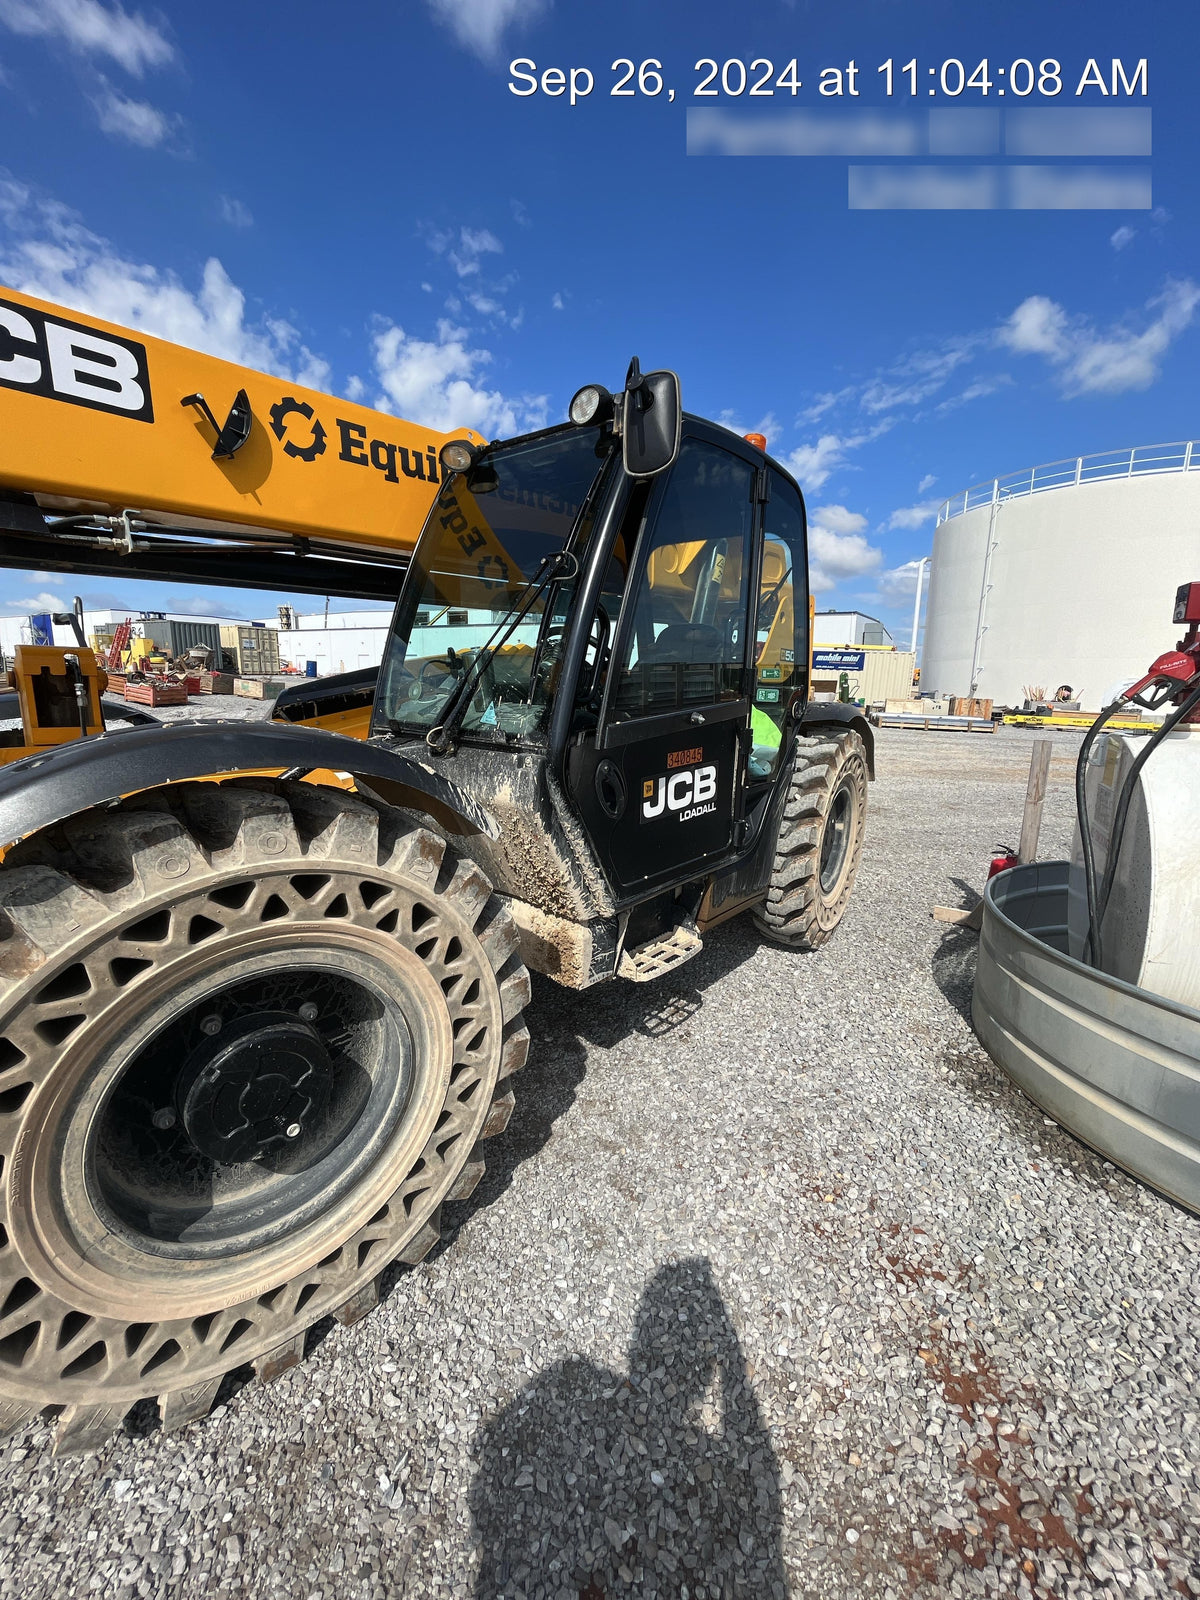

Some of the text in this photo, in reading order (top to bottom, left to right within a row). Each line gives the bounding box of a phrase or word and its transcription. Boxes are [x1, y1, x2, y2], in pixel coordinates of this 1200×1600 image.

[668, 748, 702, 767] 340845
[643, 766, 717, 818] JCB
[679, 802, 717, 822] LOADALL
